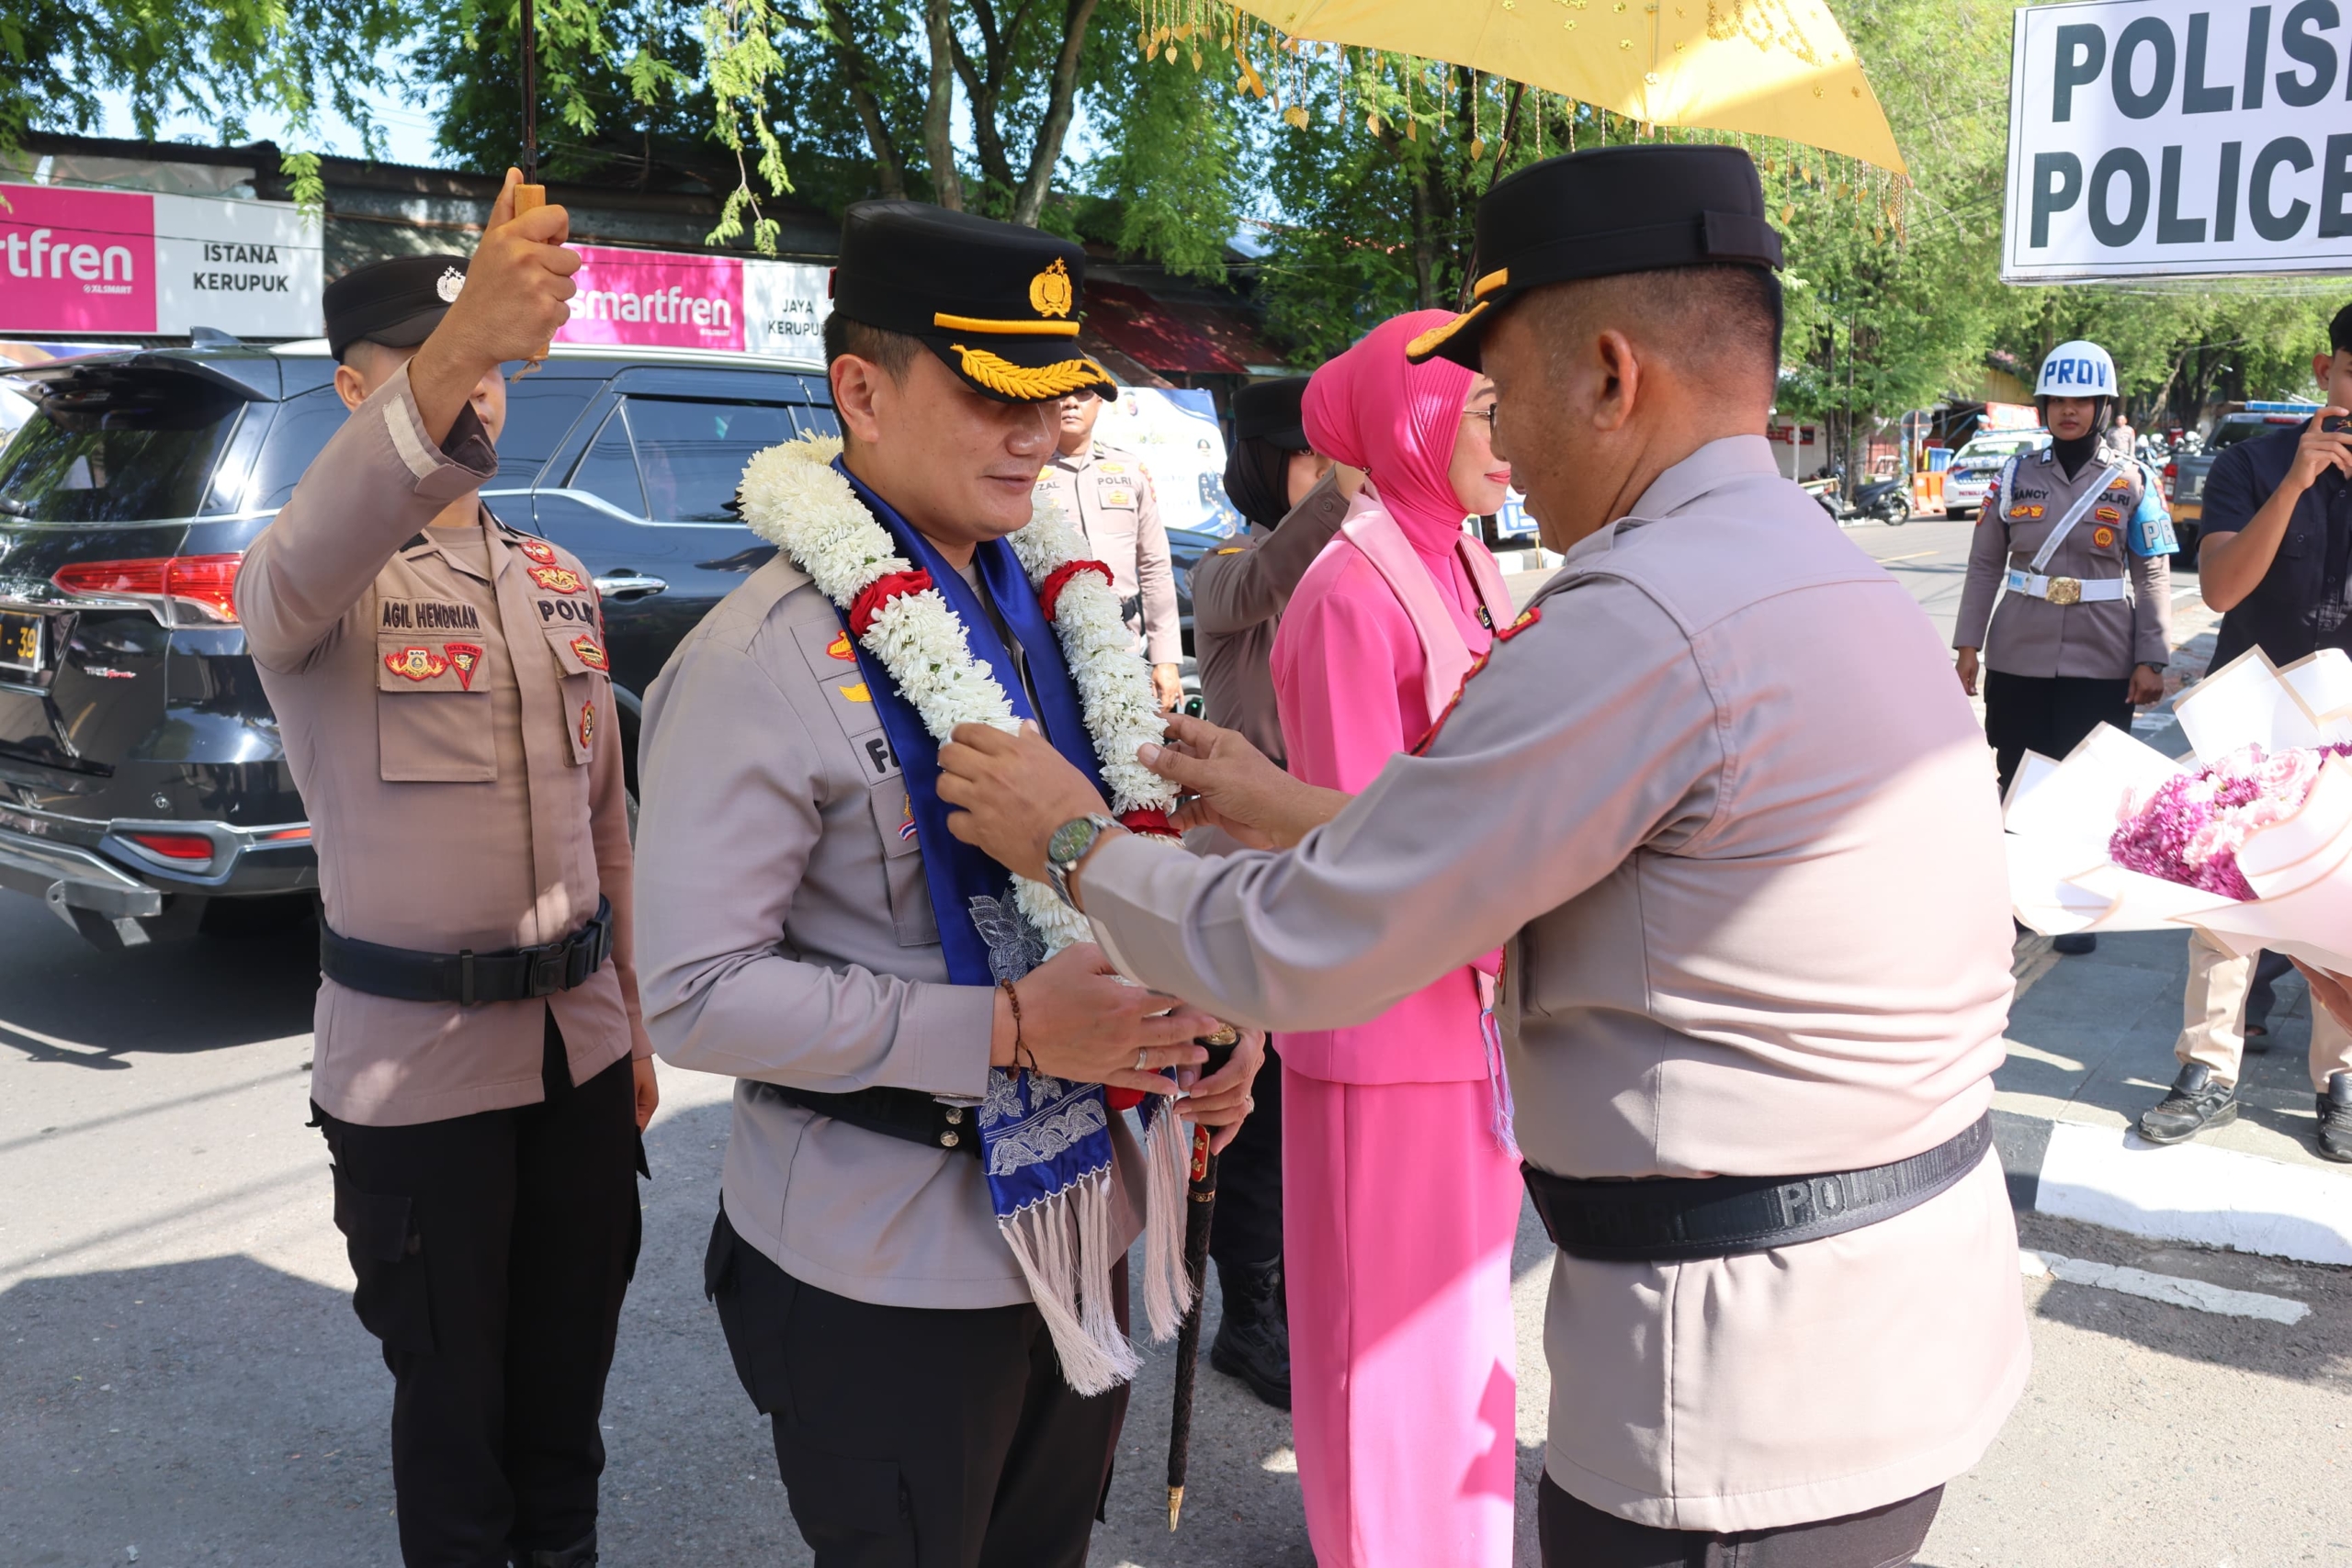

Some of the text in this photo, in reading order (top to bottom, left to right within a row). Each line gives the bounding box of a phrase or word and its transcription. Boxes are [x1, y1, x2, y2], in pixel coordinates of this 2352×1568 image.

[2052, 0, 2352, 122] POLIS
[2030, 133, 2352, 248] POLICE
[204, 243, 278, 264] ISTANA
[193, 272, 289, 292] KERUPUK
[569, 286, 731, 326] smartfren
[782, 299, 814, 314] JAYA
[767, 320, 824, 336] KERUPU
[2043, 358, 2107, 387] PROV
[1097, 477, 1131, 485] POLRI
[383, 601, 480, 630] AGIL HENDRIAN
[1778, 1164, 1907, 1227] POLRI
